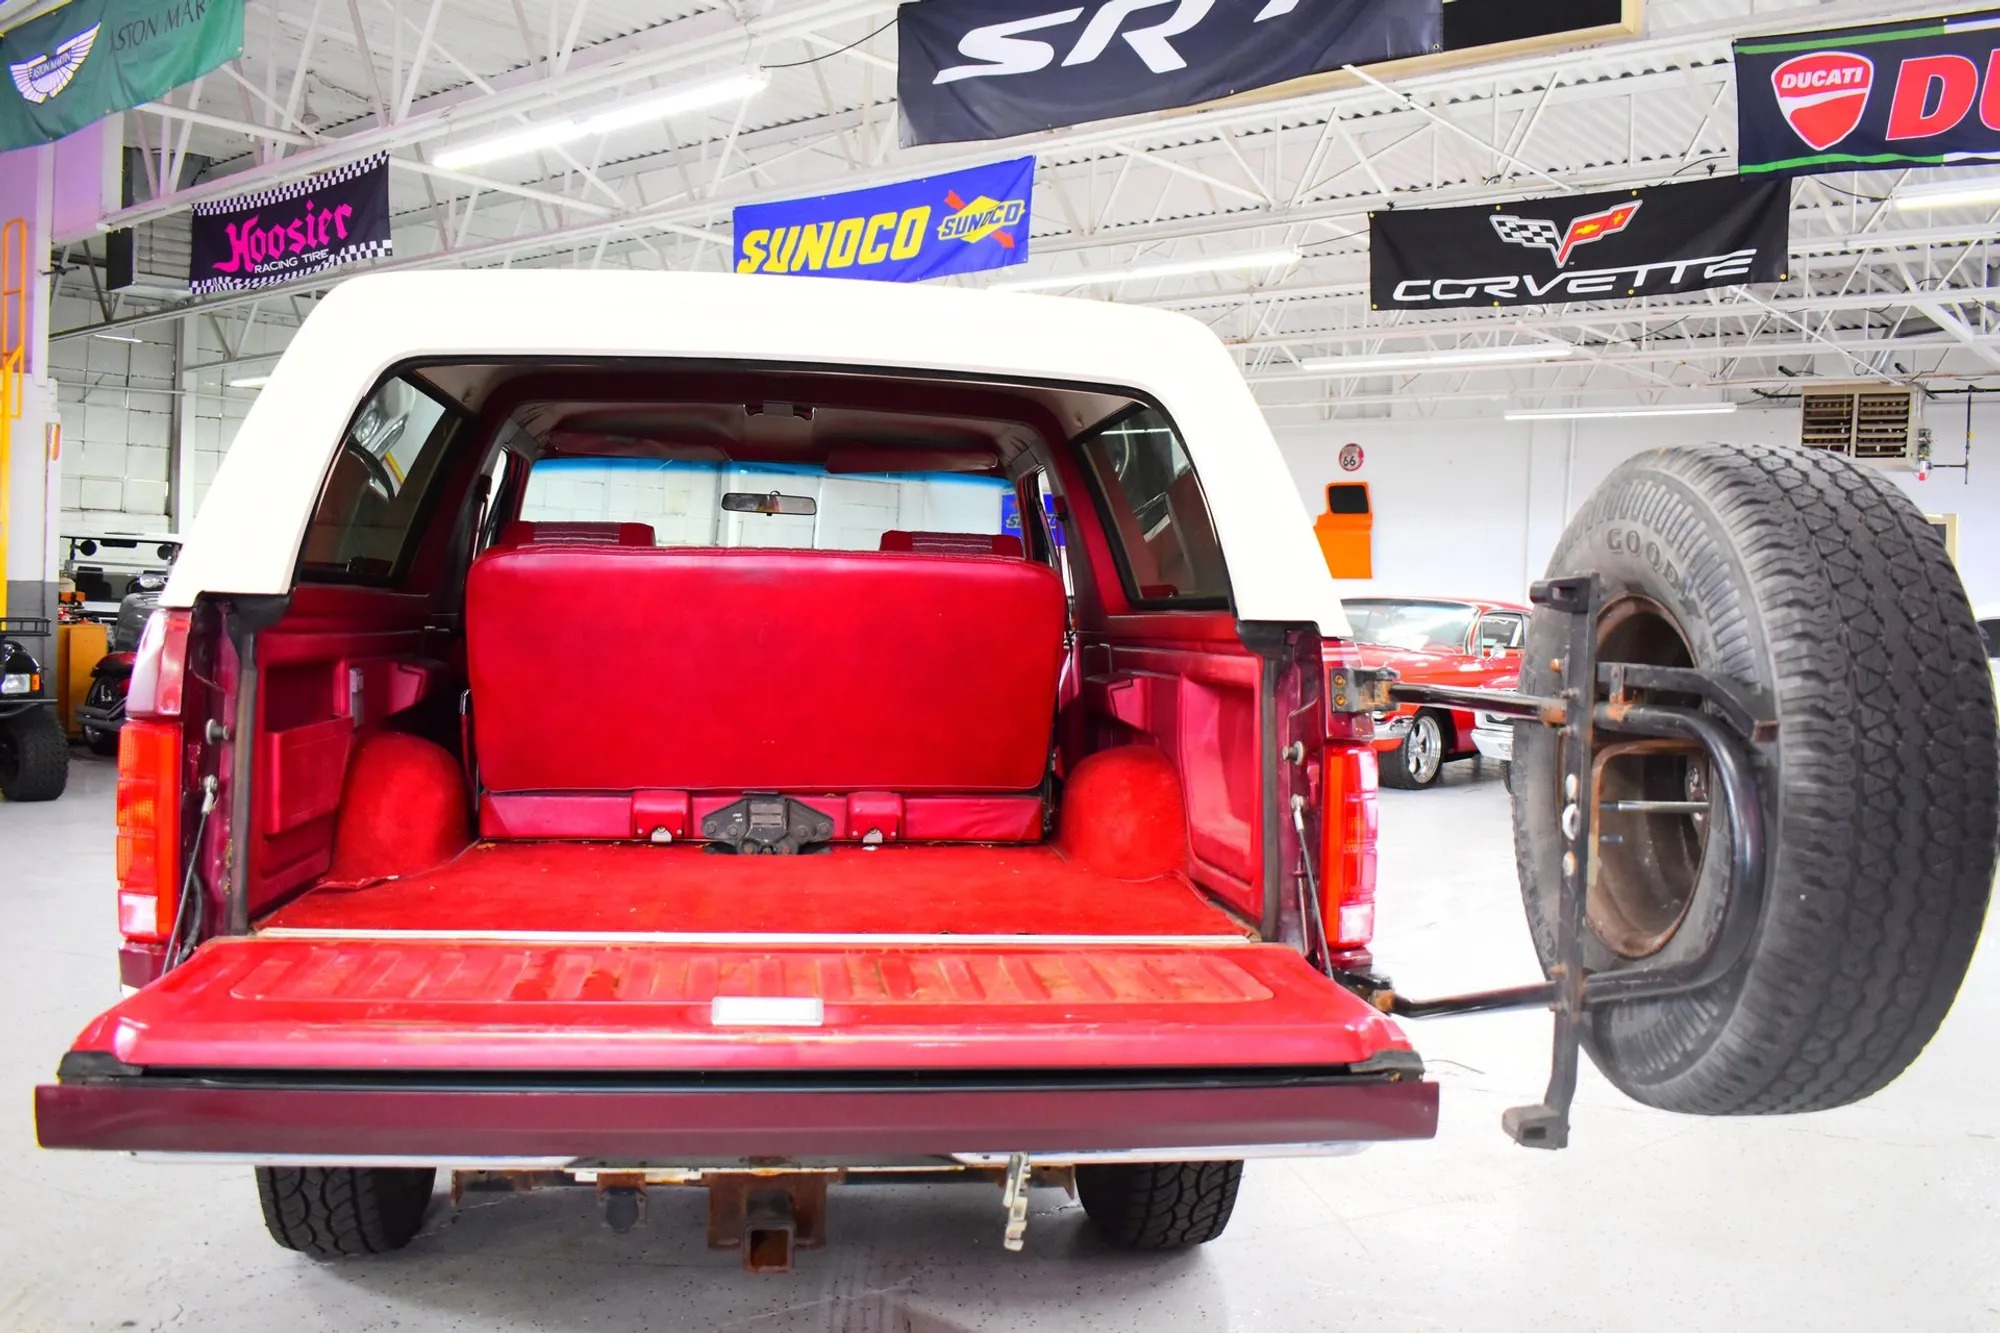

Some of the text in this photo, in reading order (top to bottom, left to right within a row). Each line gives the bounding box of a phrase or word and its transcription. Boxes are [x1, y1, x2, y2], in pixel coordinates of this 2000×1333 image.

[109, 0, 211, 55] ASTON MAR
[932, 0, 1300, 85] SR
[1781, 66, 1864, 89] DUCATI
[1885, 48, 2000, 141] D
[211, 200, 353, 273] Hoosier
[737, 205, 931, 274] SUNOCO
[941, 202, 1022, 238] SUNOCO
[254, 248, 330, 274] RACING TIRE
[1393, 248, 1757, 302] CORVETTE
[1343, 455, 1356, 467] 66
[1606, 528, 1681, 591] GOOD
